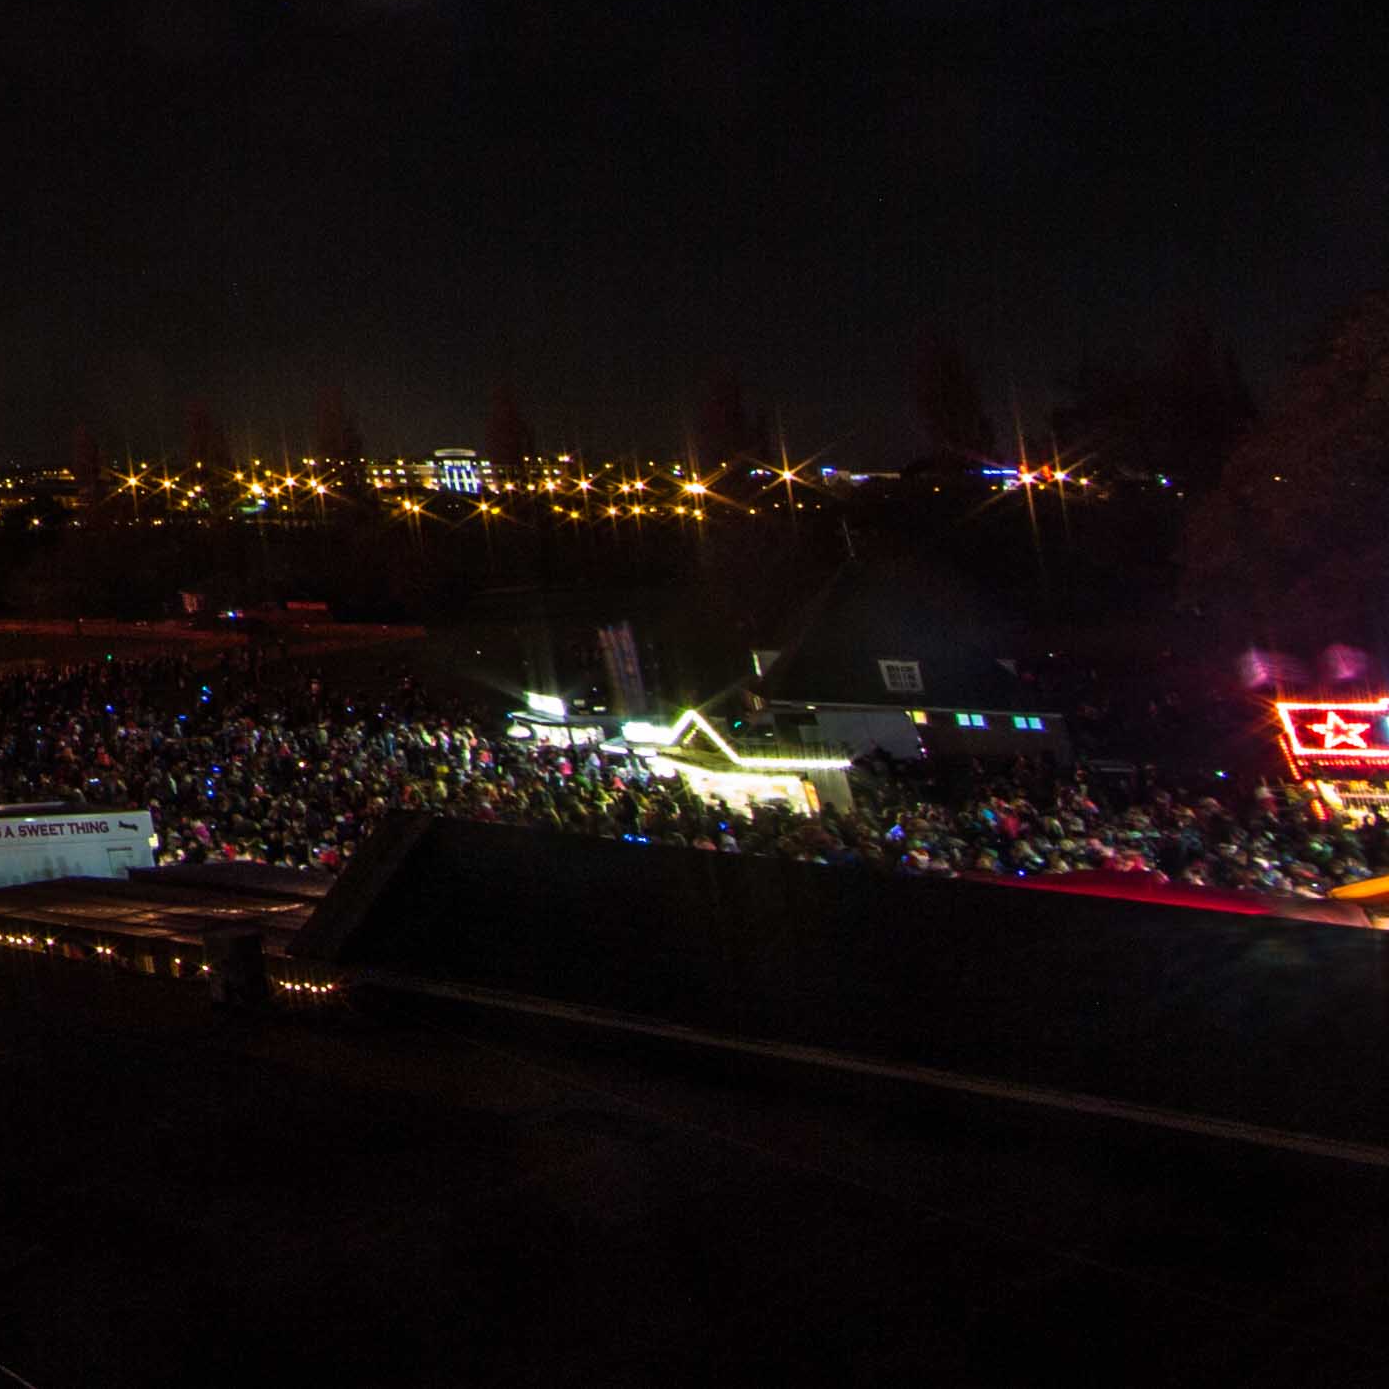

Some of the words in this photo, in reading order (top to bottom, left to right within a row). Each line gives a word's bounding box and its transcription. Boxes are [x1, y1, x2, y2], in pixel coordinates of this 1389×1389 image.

[4, 826, 14, 838] A
[18, 823, 65, 837] SWEET
[68, 821, 109, 834] THING
